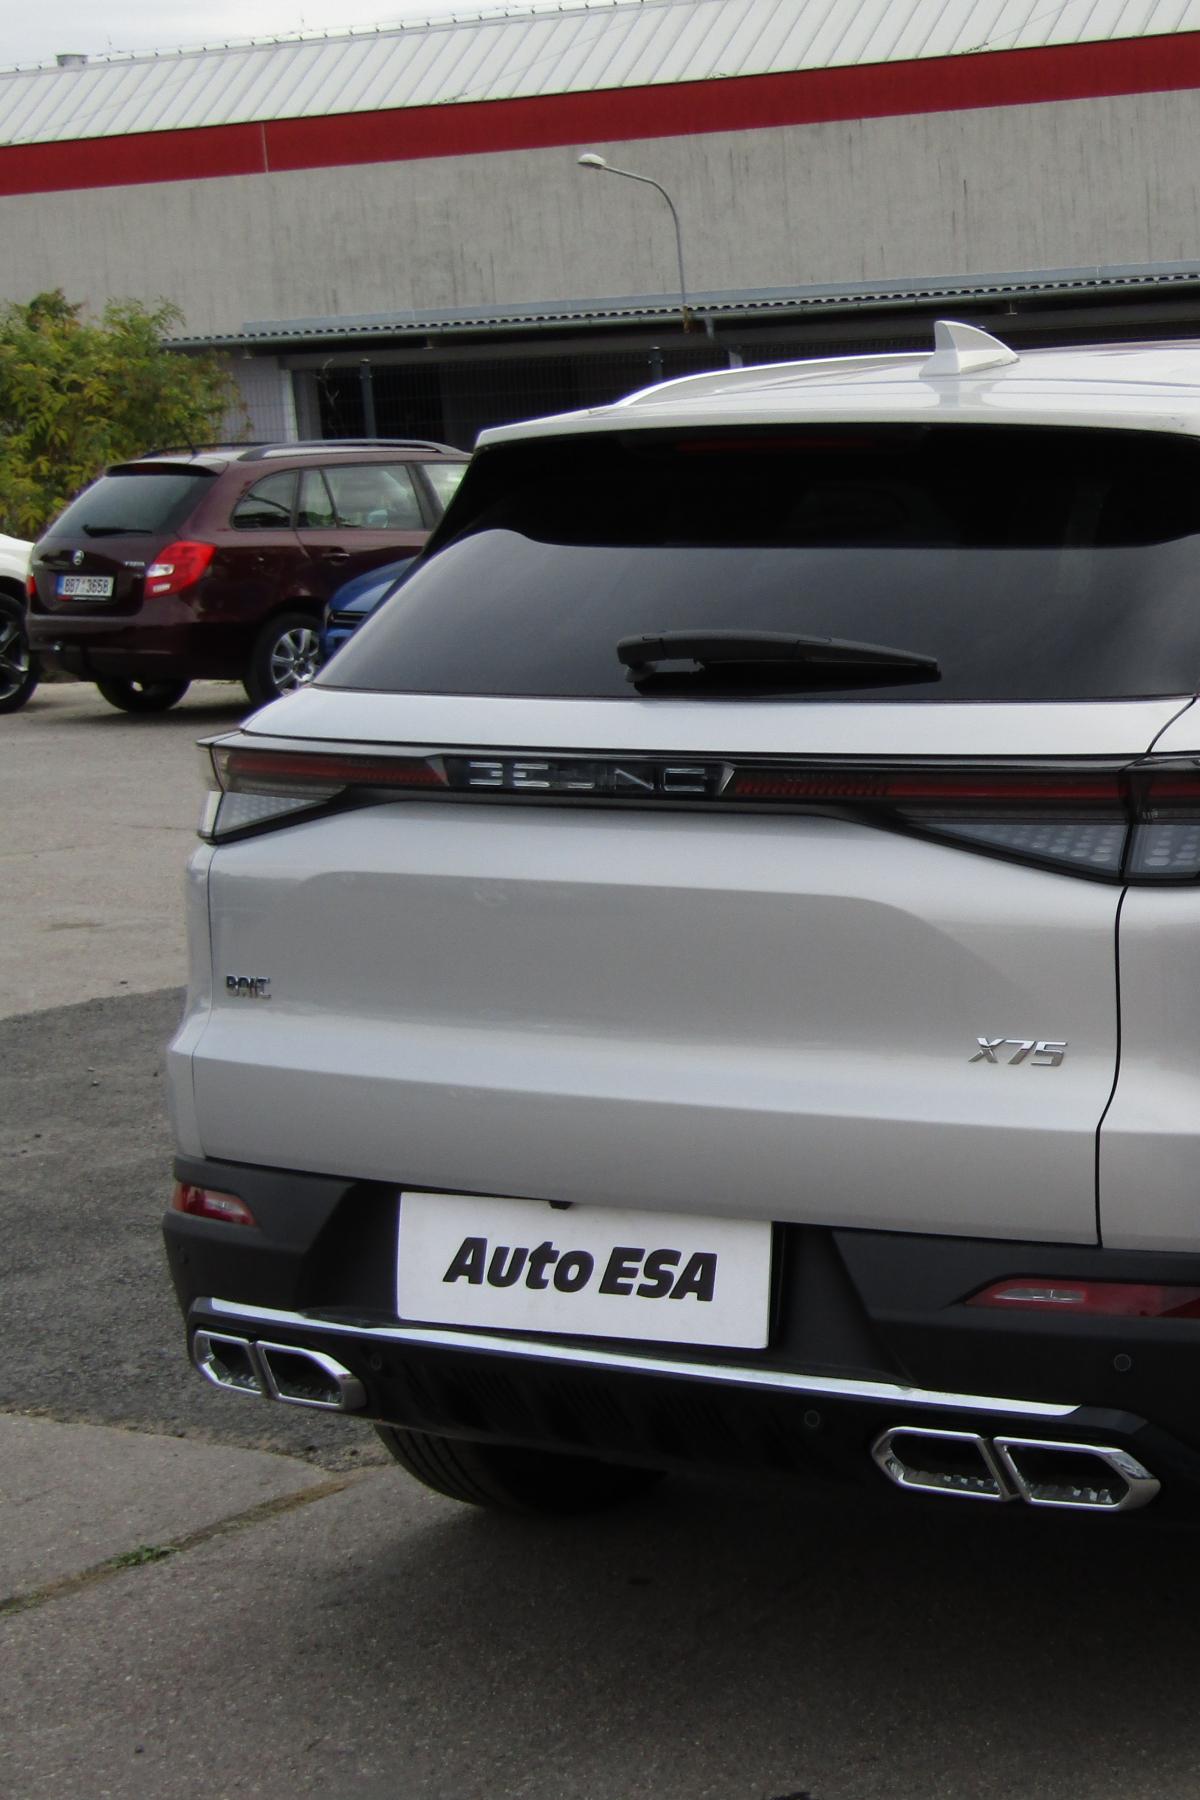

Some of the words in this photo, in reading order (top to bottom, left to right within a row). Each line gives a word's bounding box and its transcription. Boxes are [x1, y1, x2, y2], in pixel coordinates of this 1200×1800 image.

[968, 1037, 1068, 1067] X75
[442, 1236, 595, 1294] Auto
[598, 1246, 718, 1302] ESA
